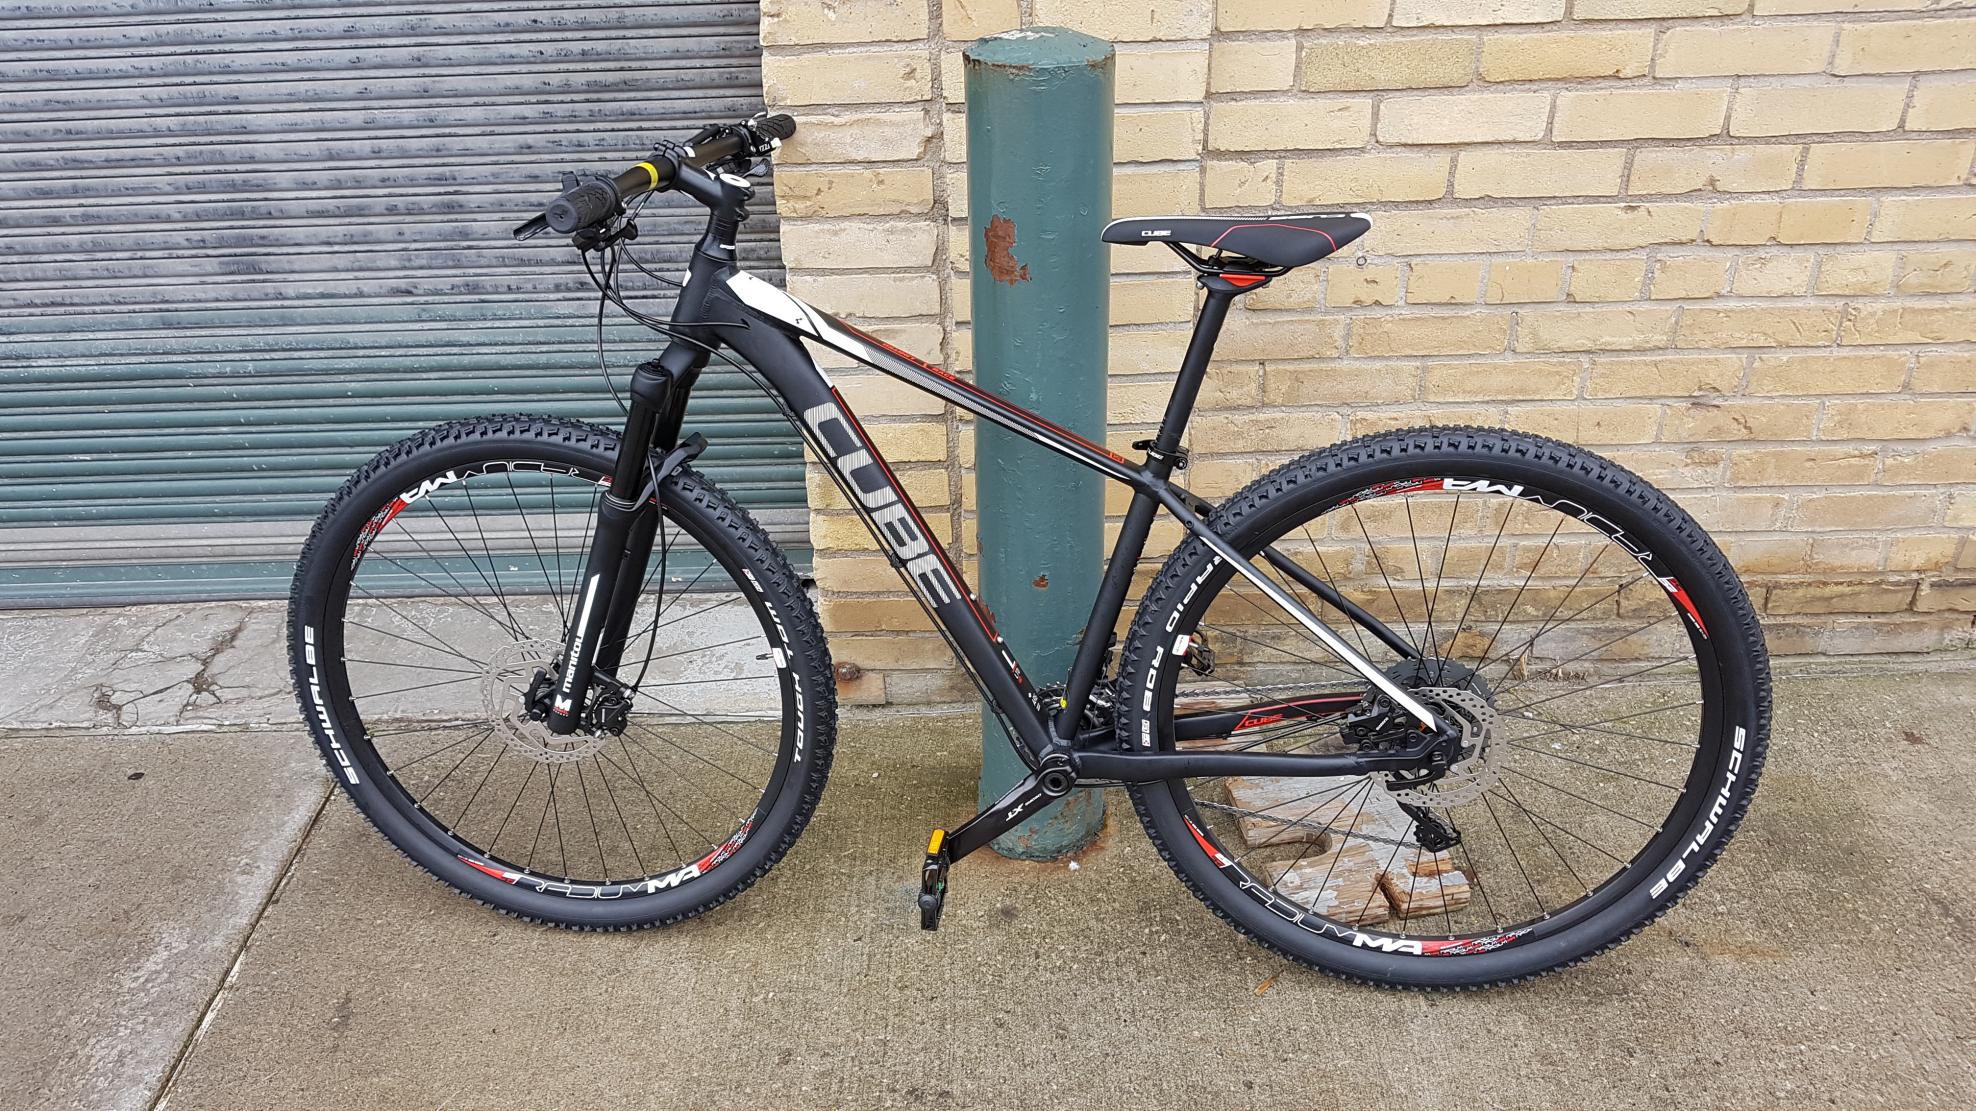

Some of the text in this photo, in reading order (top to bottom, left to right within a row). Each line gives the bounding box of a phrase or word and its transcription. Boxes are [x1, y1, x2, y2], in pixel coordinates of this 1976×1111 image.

[1141, 229, 1171, 237] CUBE
[804, 402, 961, 608] CUBE
[765, 601, 793, 659] TOM
[1165, 555, 1223, 633] RAPID
[562, 636, 583, 693] manitou
[1142, 645, 1164, 712] ROB
[304, 625, 360, 785] SCHWALBE
[1650, 725, 1746, 900] SCHWALBE
